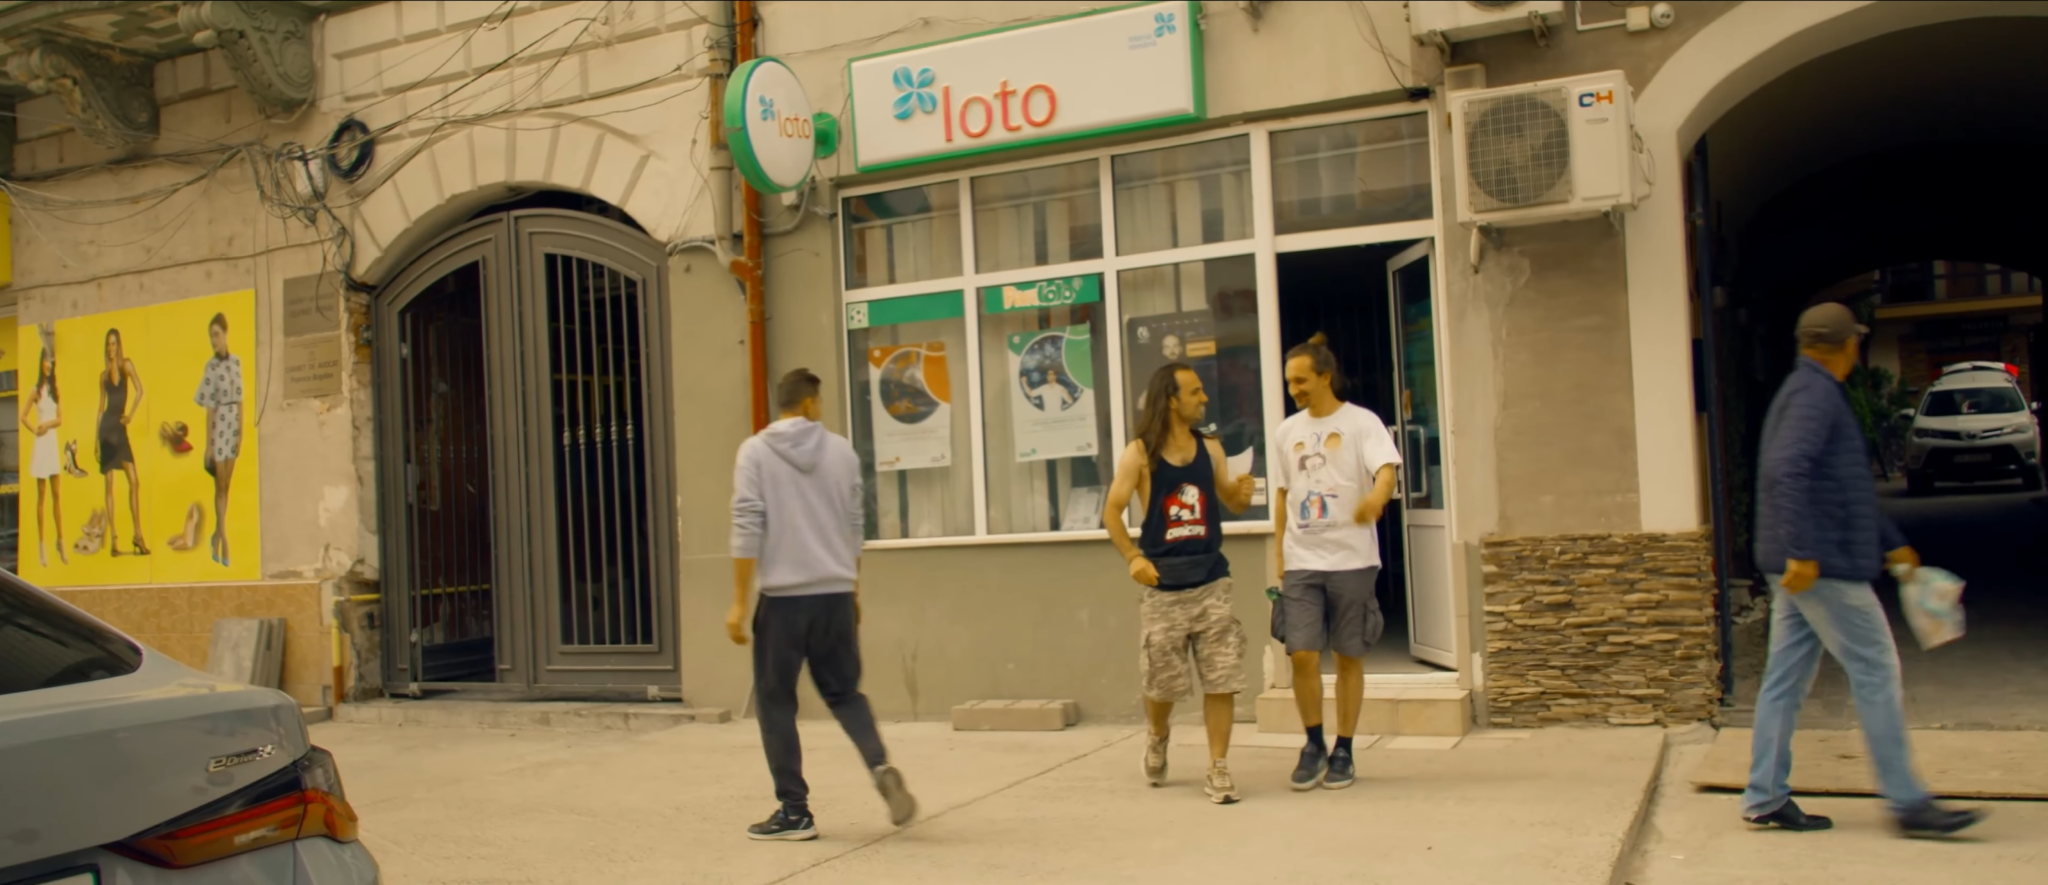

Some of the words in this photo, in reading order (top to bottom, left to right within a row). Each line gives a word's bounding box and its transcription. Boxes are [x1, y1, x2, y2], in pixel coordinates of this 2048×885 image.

[942, 79, 1057, 142] loto
[1579, 90, 1613, 107] CH
[777, 109, 811, 139] loto
